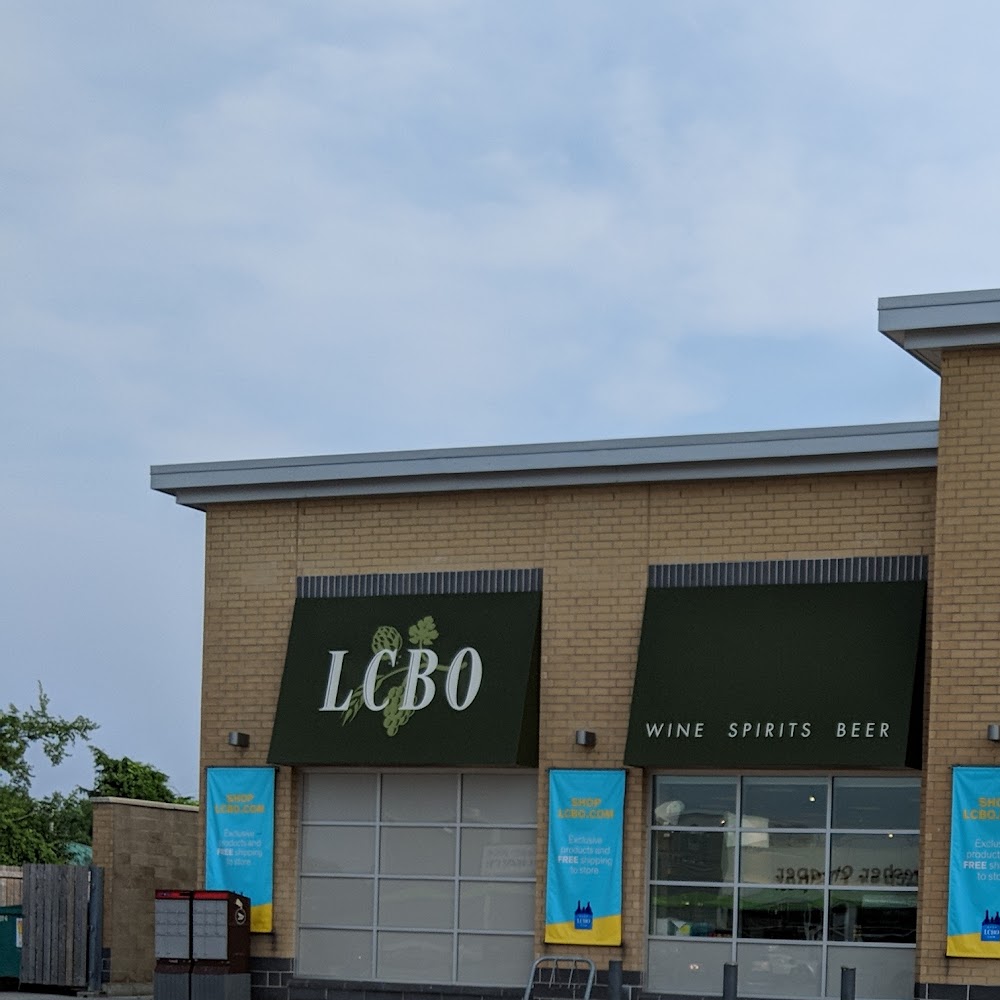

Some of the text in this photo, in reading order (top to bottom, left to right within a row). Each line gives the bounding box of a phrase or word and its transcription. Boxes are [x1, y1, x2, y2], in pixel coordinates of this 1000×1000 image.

[318, 646, 483, 711] LCBO
[645, 722, 891, 738] WINE SPIRITS BEER
[571, 797, 602, 807] SHOP
[557, 808, 614, 819] LCBO.COM
[568, 835, 603, 844] Exclusive
[217, 848, 233, 856] FREE
[560, 846, 610, 855] products and
[557, 855, 613, 866] FREE shipping
[963, 861, 987, 870] FREE
[569, 866, 599, 875] to store
[977, 872, 986, 881] to
